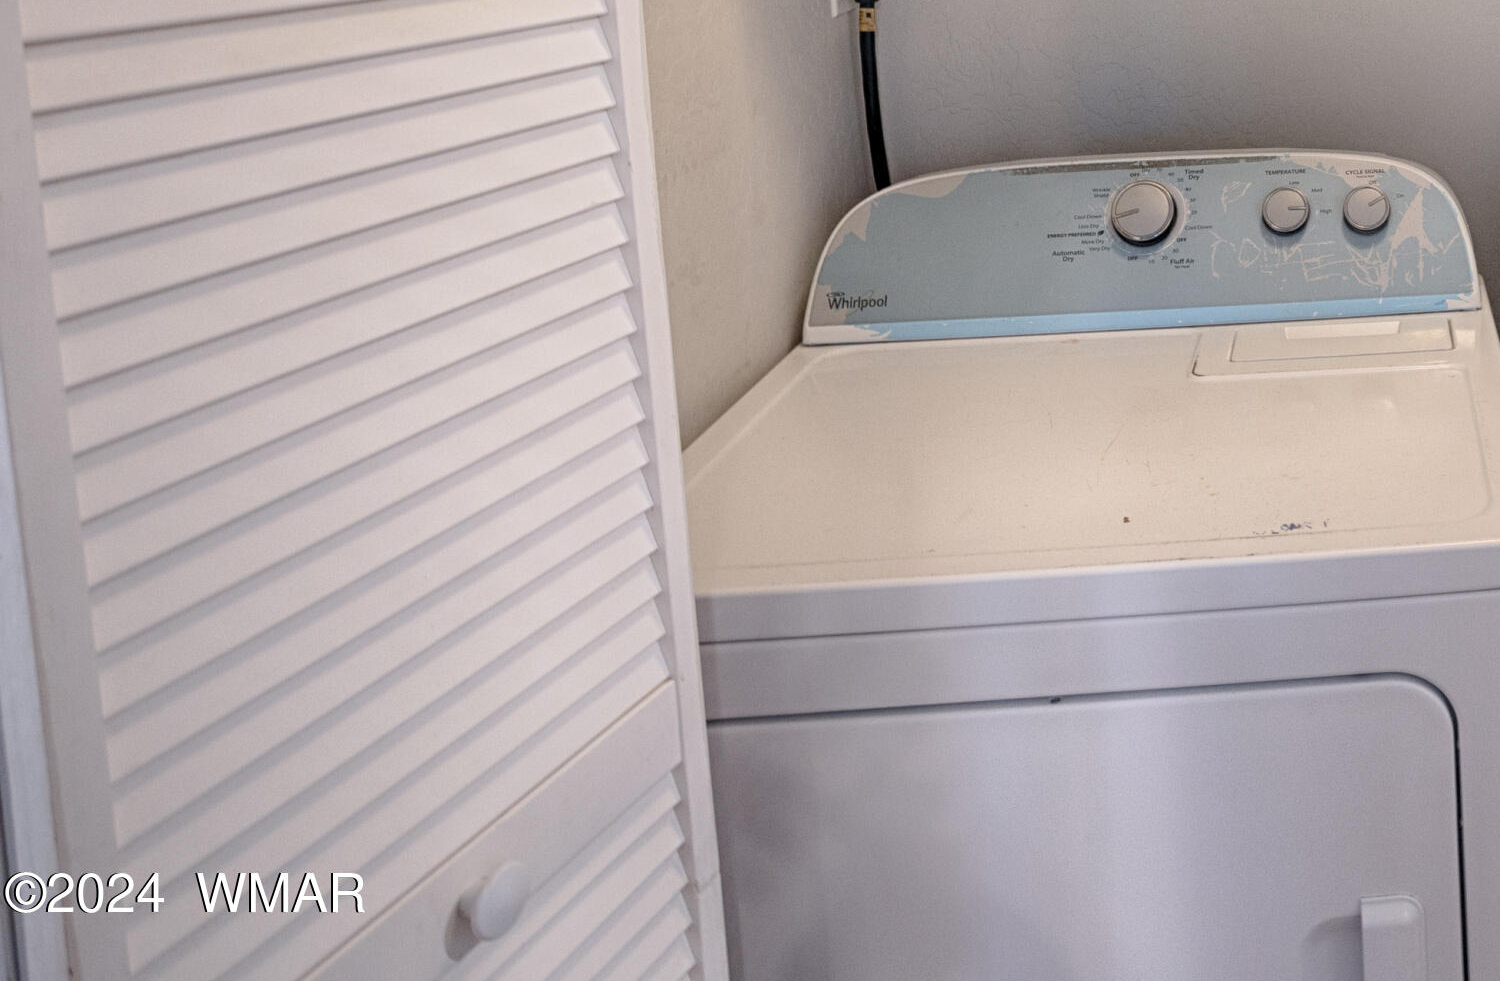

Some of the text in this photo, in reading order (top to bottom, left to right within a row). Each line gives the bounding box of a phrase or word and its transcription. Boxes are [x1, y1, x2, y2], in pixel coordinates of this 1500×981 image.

[1320, 208, 1333, 216] High
[1052, 249, 1085, 257] Automatic
[828, 294, 888, 312] Whirlpool
